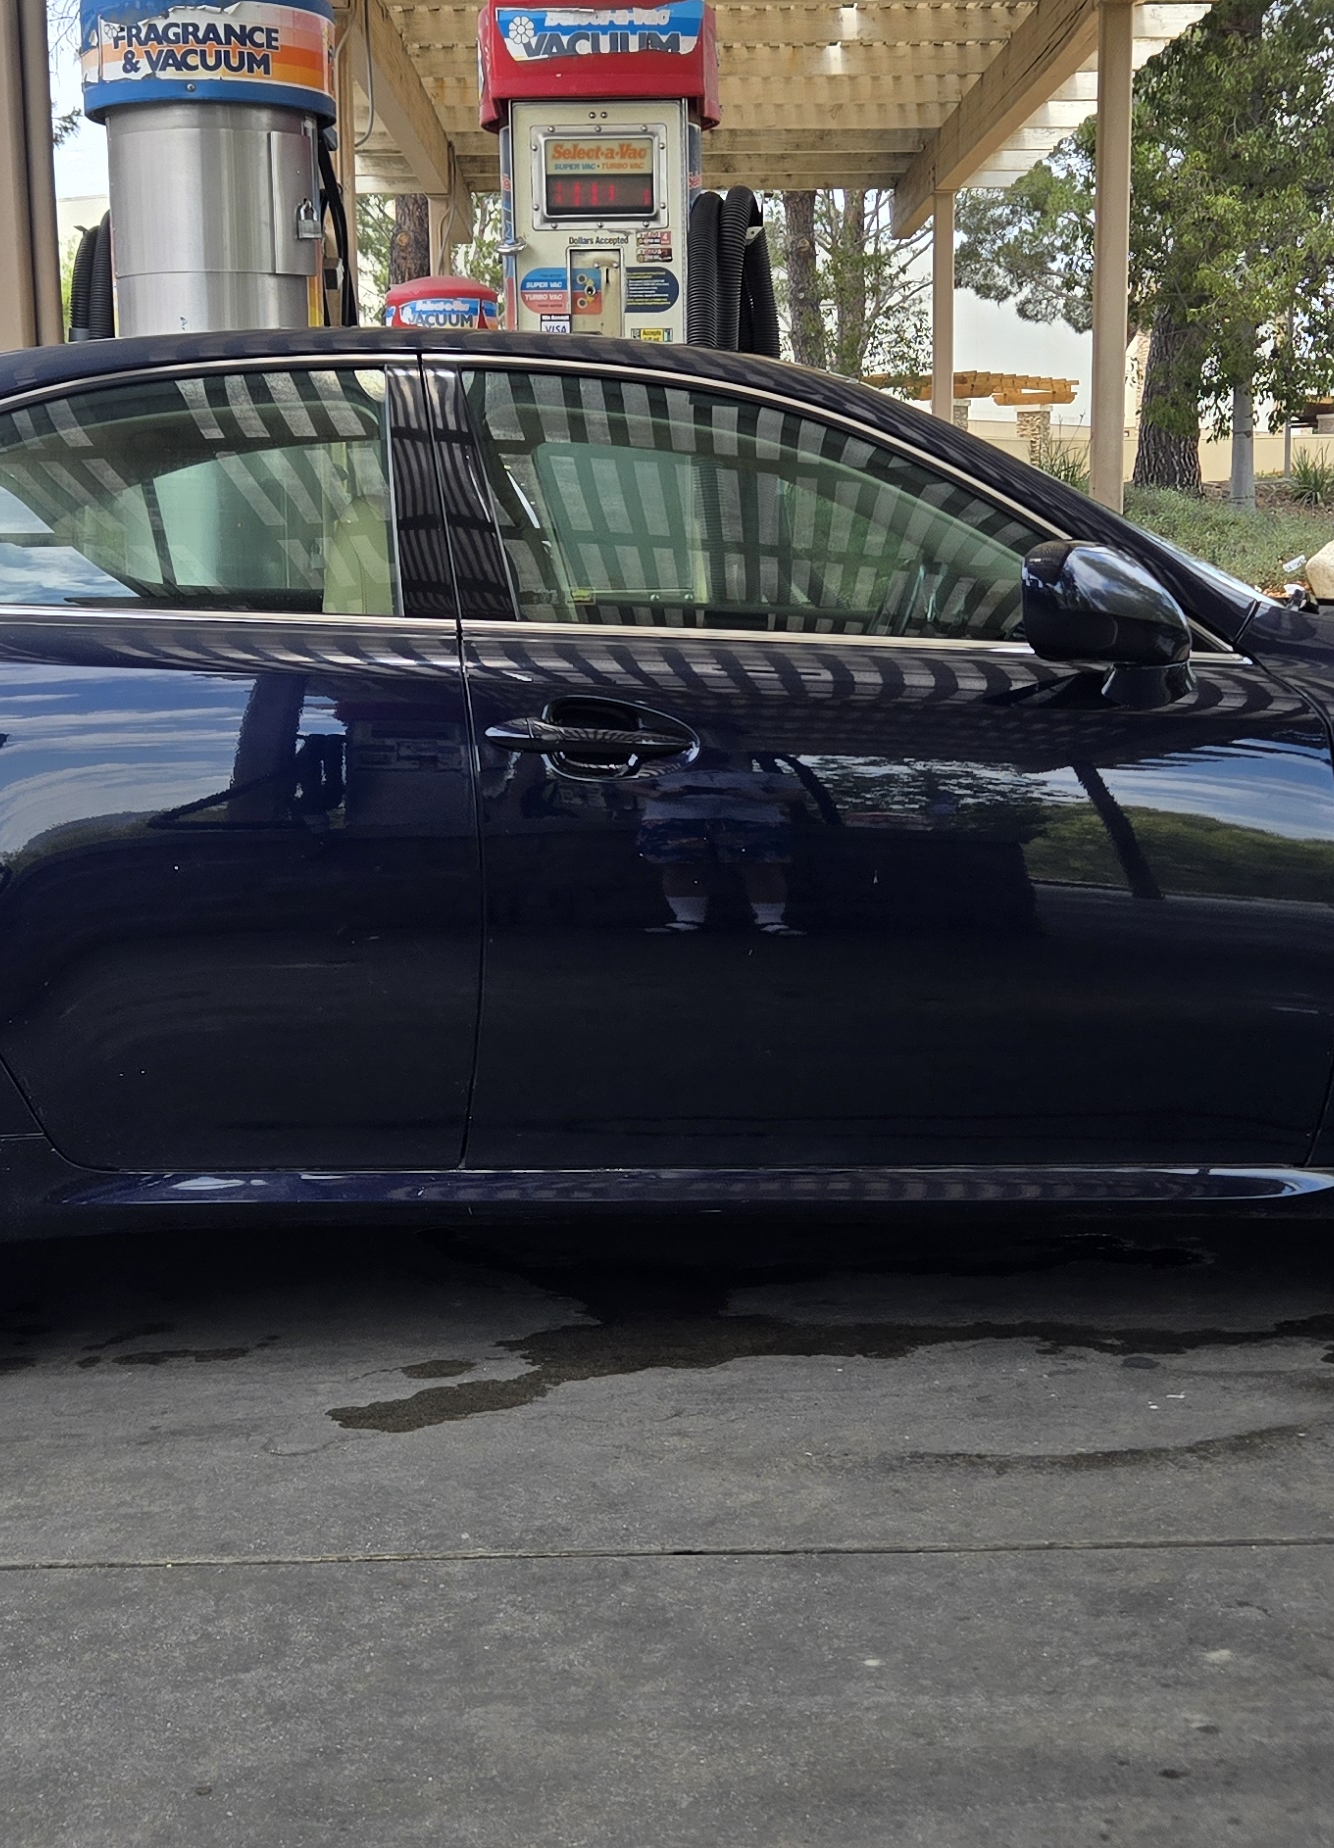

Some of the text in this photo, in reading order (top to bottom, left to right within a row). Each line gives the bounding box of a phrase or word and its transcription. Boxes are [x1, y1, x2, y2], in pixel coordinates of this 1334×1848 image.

[113, 22, 279, 51] FRAGRANCE
[522, 32, 681, 57] VACUUM
[122, 49, 271, 75] & VACUUM
[601, 162, 628, 170] TURBO
[595, 236, 629, 245] Accepted
[408, 314, 473, 328] VACUUM
[545, 325, 567, 333] VISA
